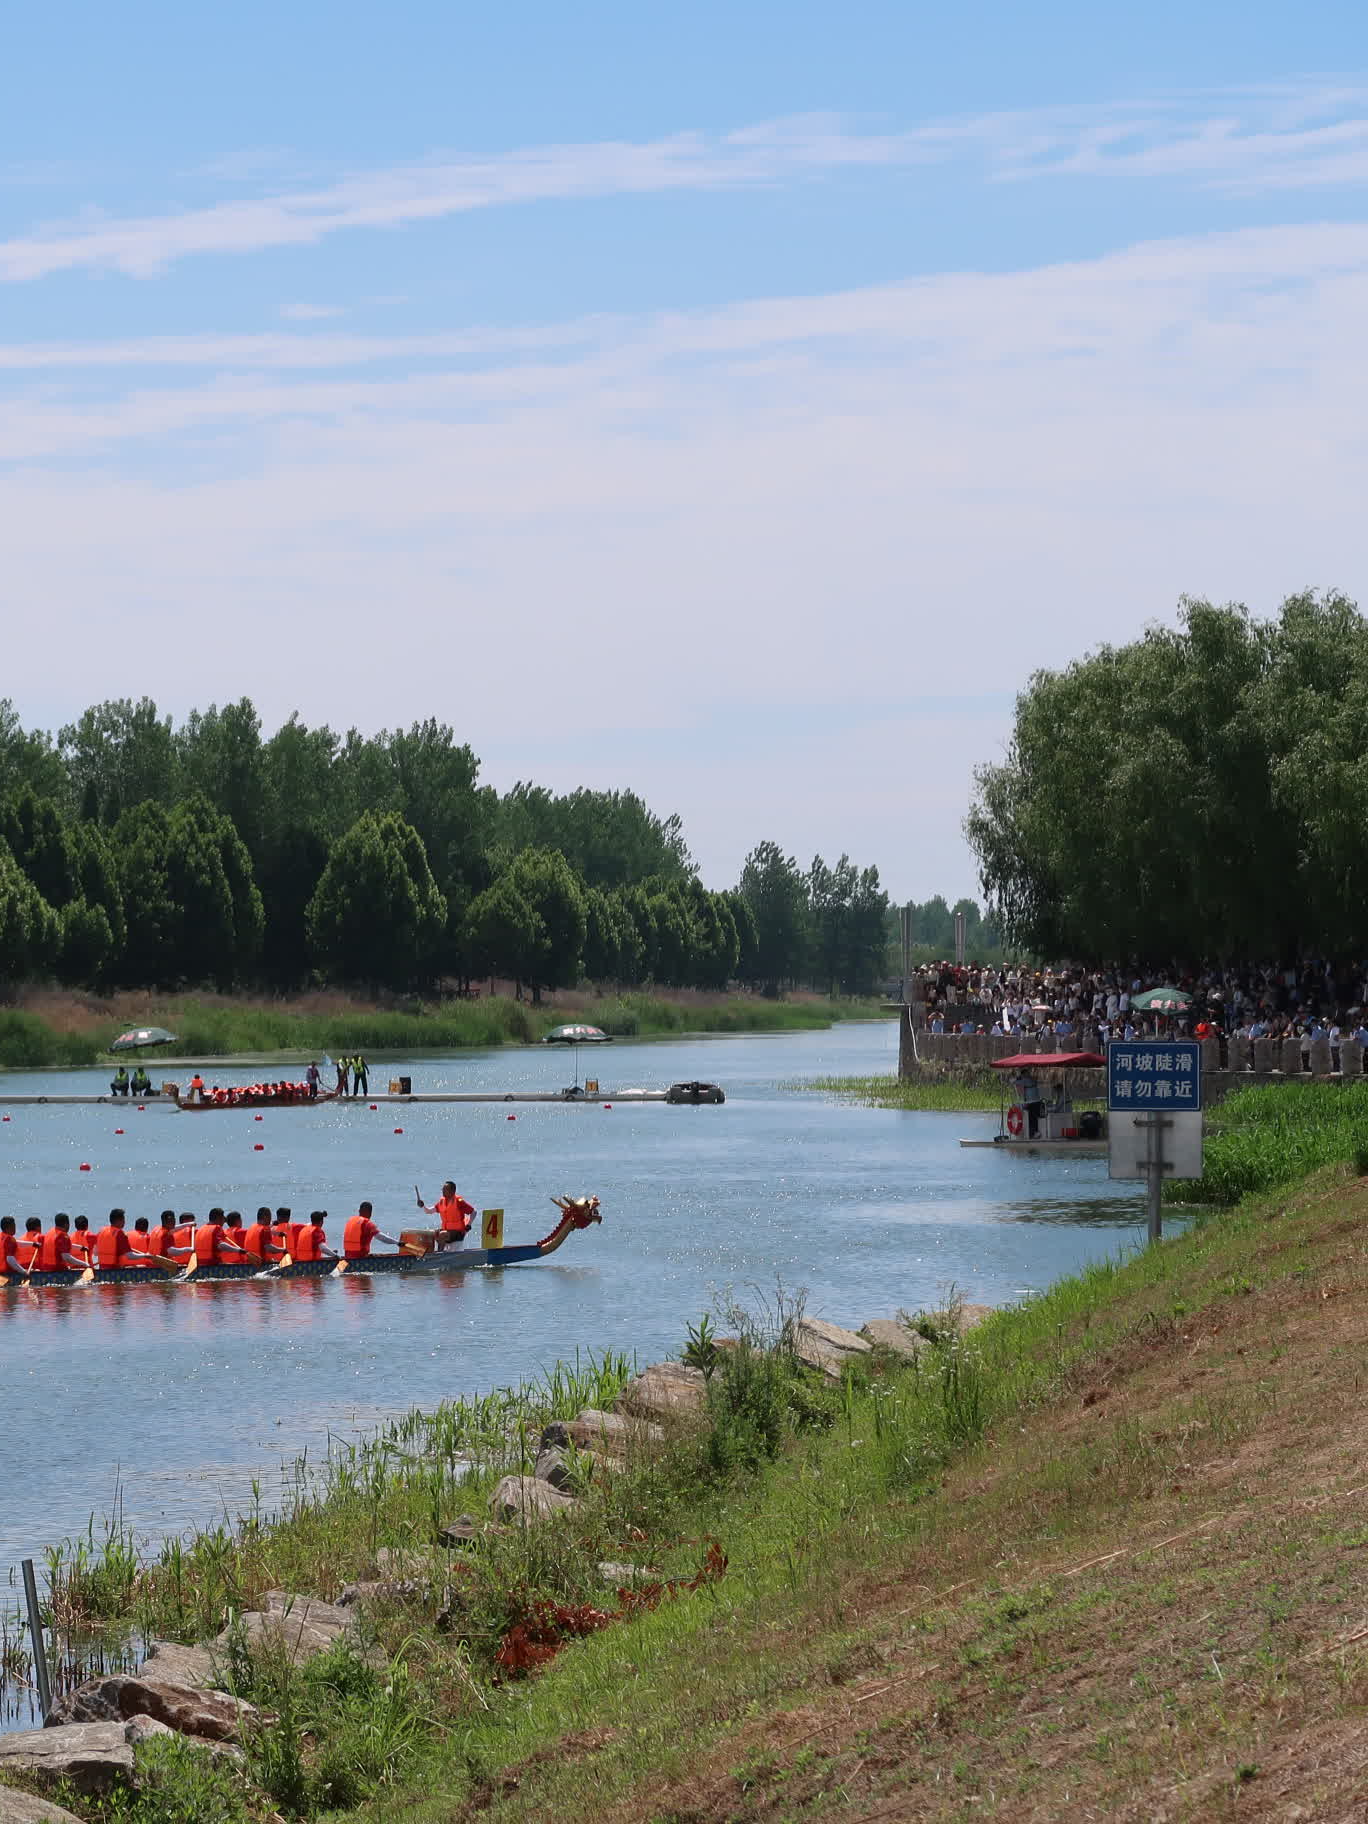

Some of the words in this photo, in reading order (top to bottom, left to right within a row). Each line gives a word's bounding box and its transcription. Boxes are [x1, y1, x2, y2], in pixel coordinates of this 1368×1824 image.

[1115, 1053, 1193, 1072] 河坡陡滑
[1114, 1080, 1193, 1099] 请勿靠近
[486, 1214, 498, 1238] 4
